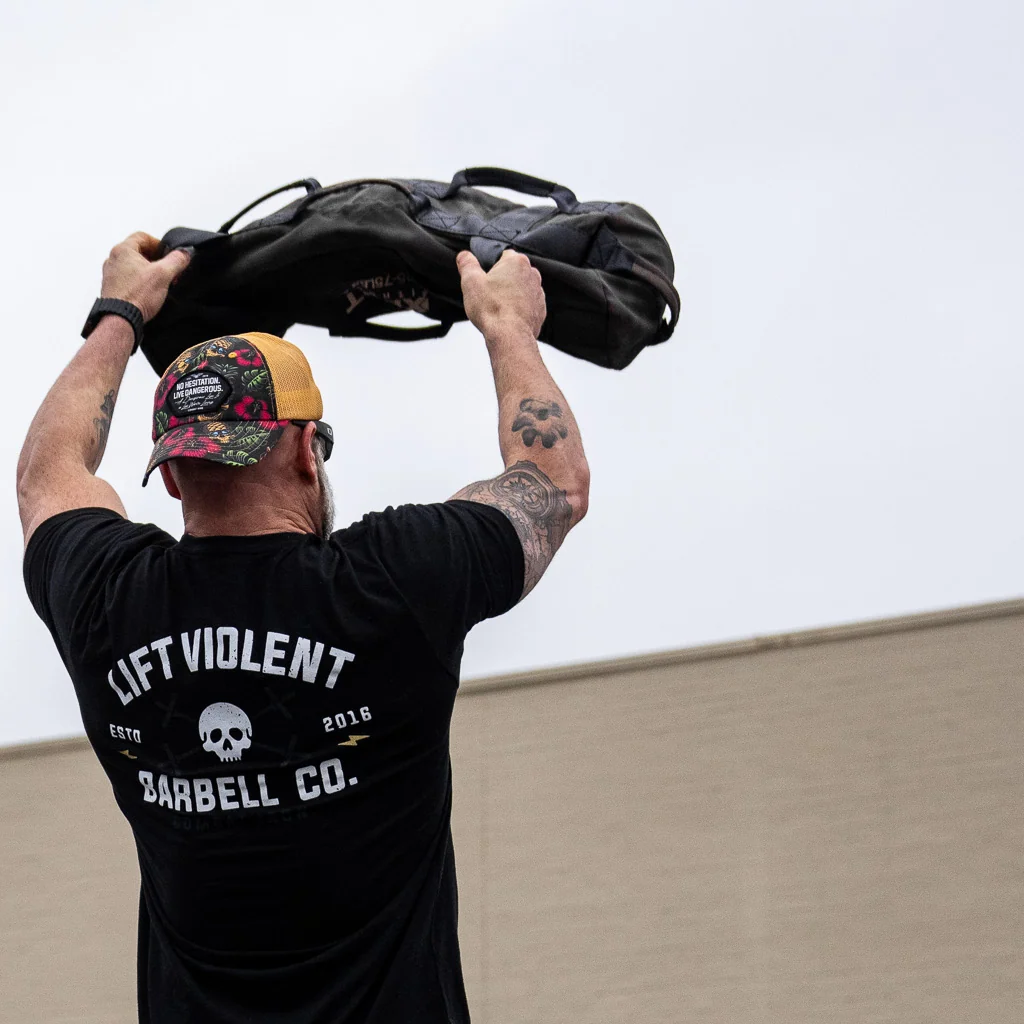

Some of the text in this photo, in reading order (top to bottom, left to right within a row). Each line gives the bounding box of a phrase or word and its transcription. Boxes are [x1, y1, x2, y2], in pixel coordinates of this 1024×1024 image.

[174, 385, 223, 399] LIVE DANGEROUS.
[185, 377, 220, 388] HESITATION.
[108, 626, 356, 706] LIFT VIOLENT
[322, 706, 372, 733] 2016
[138, 758, 359, 813] BARBELL CO.
